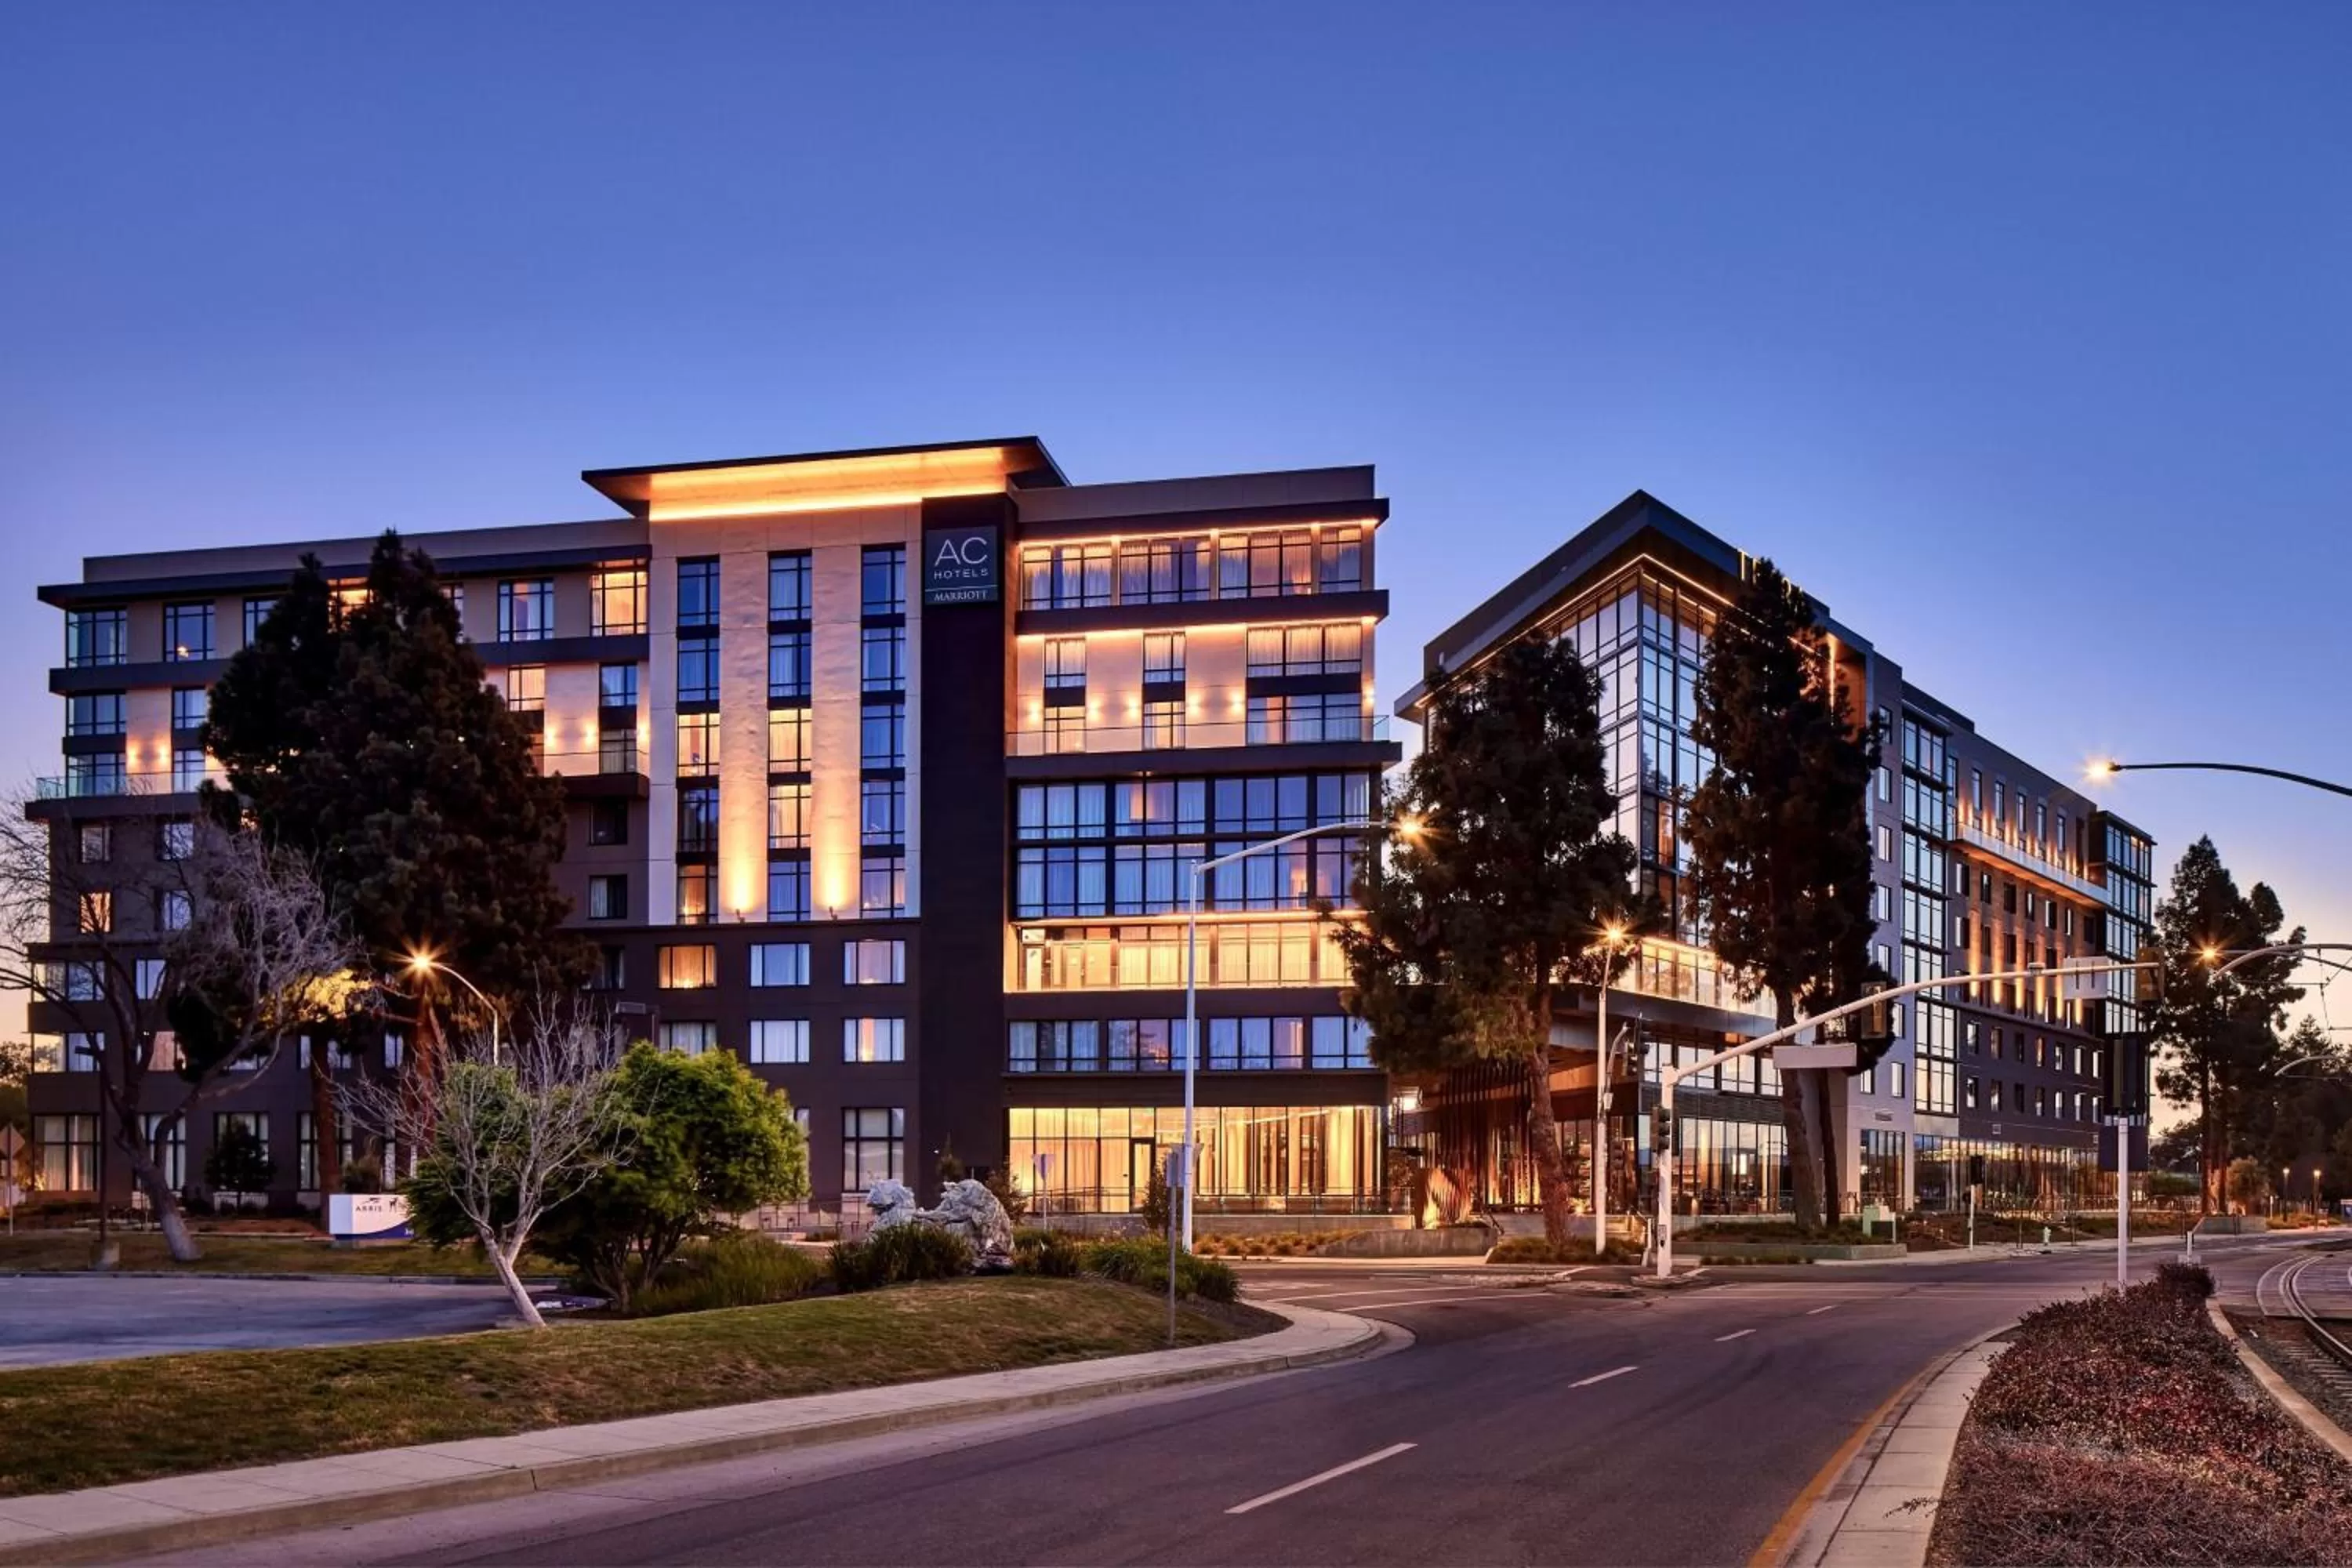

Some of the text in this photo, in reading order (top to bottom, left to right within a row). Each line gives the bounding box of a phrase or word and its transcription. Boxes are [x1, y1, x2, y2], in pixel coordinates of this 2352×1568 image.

[935, 536, 988, 566] AC
[934, 568, 988, 579] HOTELS
[934, 590, 988, 601] MARRIOTT
